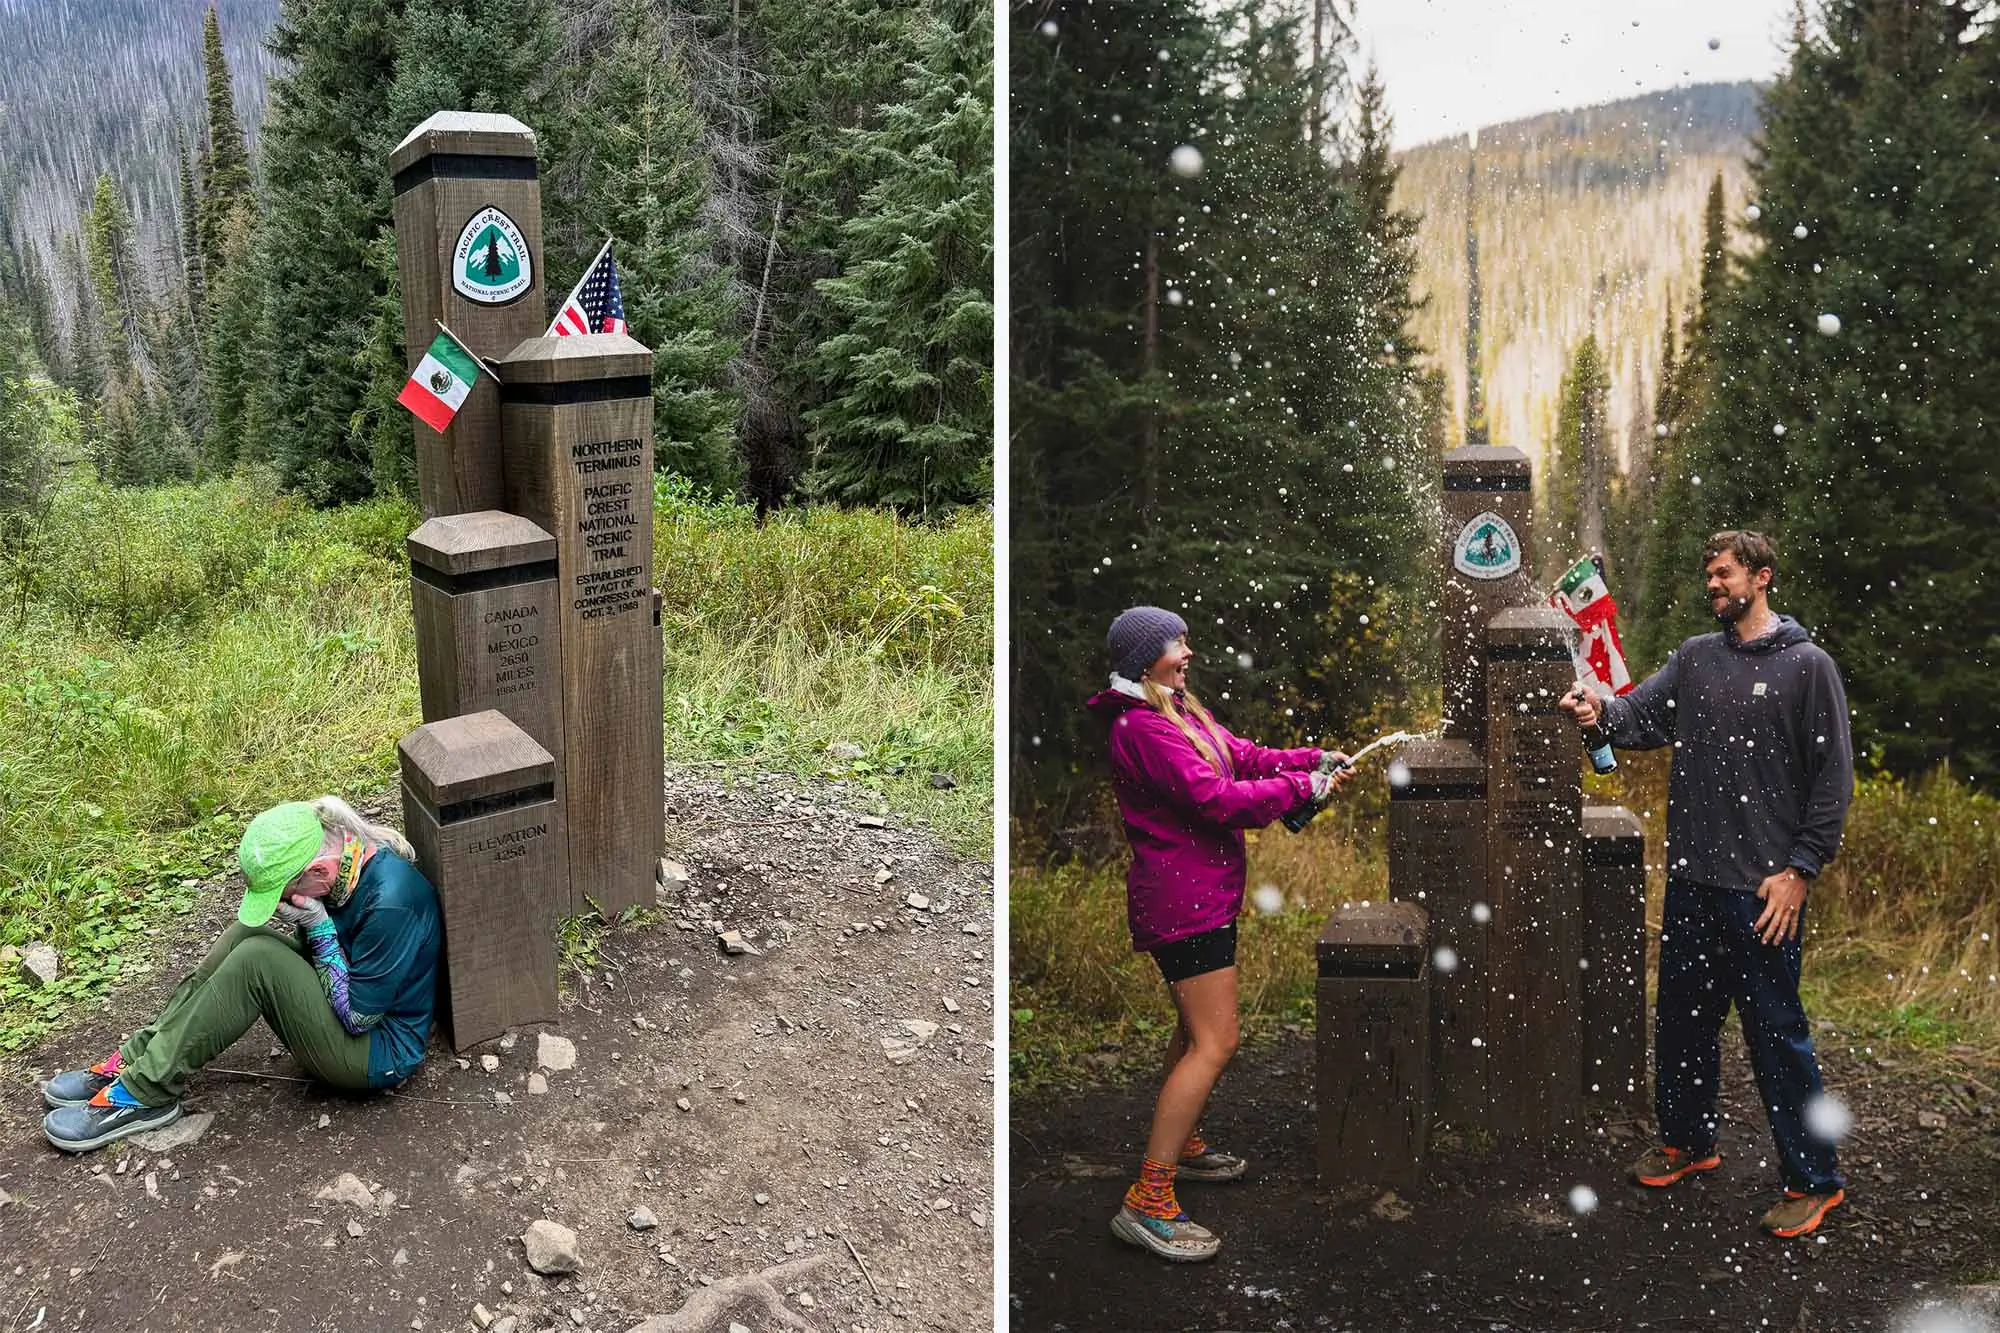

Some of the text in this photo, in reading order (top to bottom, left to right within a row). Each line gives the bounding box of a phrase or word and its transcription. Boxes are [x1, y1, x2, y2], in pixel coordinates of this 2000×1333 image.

[459, 213, 527, 261] PACIFIC CREST TRAIL
[461, 280, 489, 296] NATIONAL
[510, 278, 527, 292] TRAIL
[572, 438, 643, 458] NORTHERN
[575, 454, 641, 474] TERMINUS
[584, 482, 632, 500] PACIFIC
[587, 498, 630, 515] CREST
[578, 513, 639, 532] NATIONAL
[586, 529, 632, 548] SCENIC
[592, 546, 628, 561] TRAIL
[576, 565, 642, 585] ESTABLISHED
[584, 578, 634, 596] BY ACT OF
[574, 588, 646, 610] CONGRESS ON
[484, 606, 538, 624] CANADA
[582, 607, 605, 620] OCT.
[503, 623, 522, 636] TO
[488, 635, 539, 654] MEXICO
[500, 651, 529, 667] 2650
[496, 666, 534, 683] MILES
[468, 823, 547, 854] ELEVATION
